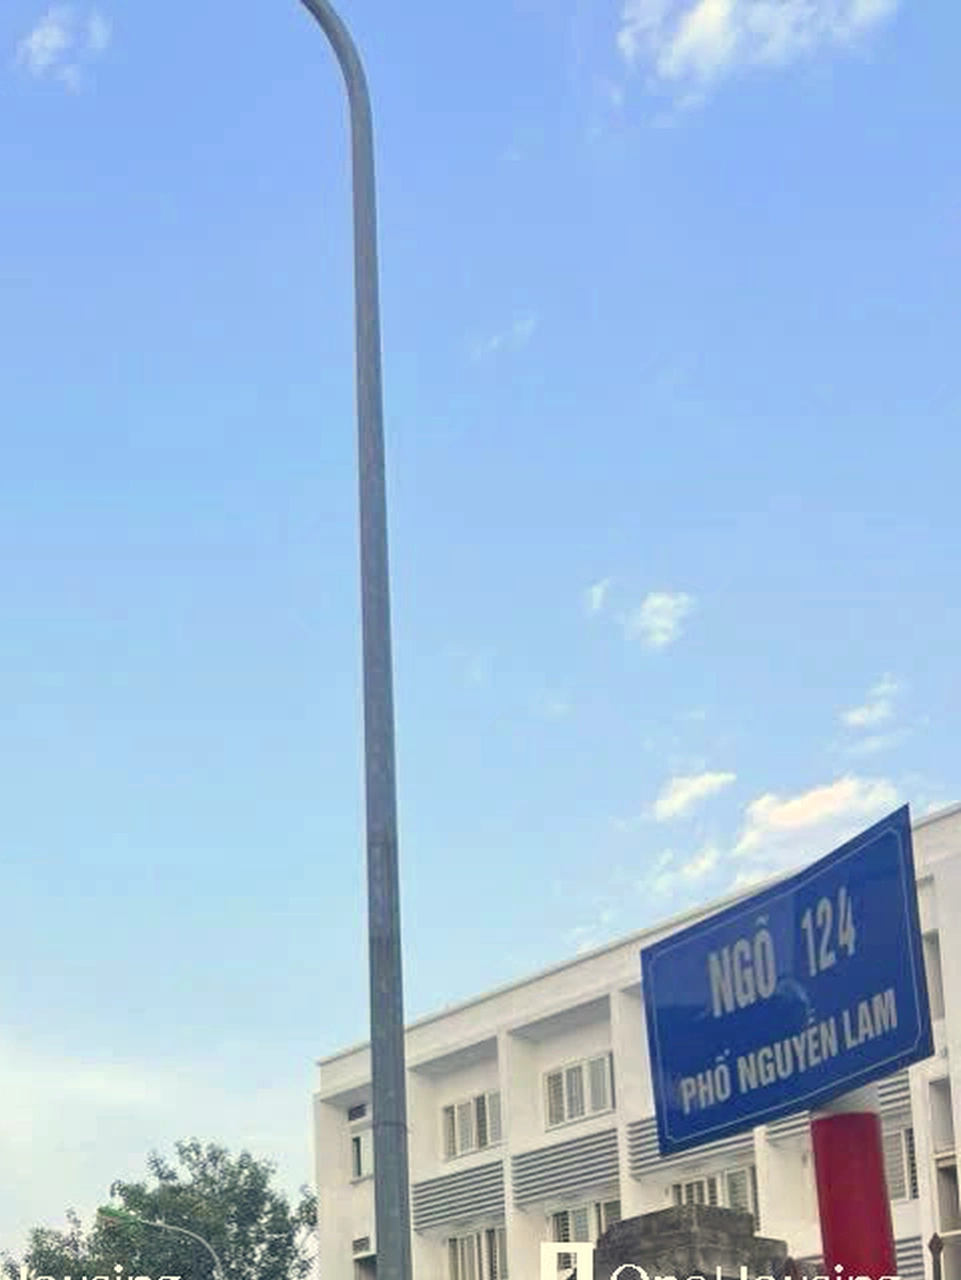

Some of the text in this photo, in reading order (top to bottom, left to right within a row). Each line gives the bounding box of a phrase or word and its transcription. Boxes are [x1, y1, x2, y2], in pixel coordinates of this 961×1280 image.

[707, 886, 857, 1018] NGÕ 124
[680, 1049, 731, 1115] PHỐ
[843, 989, 898, 1049] LAM
